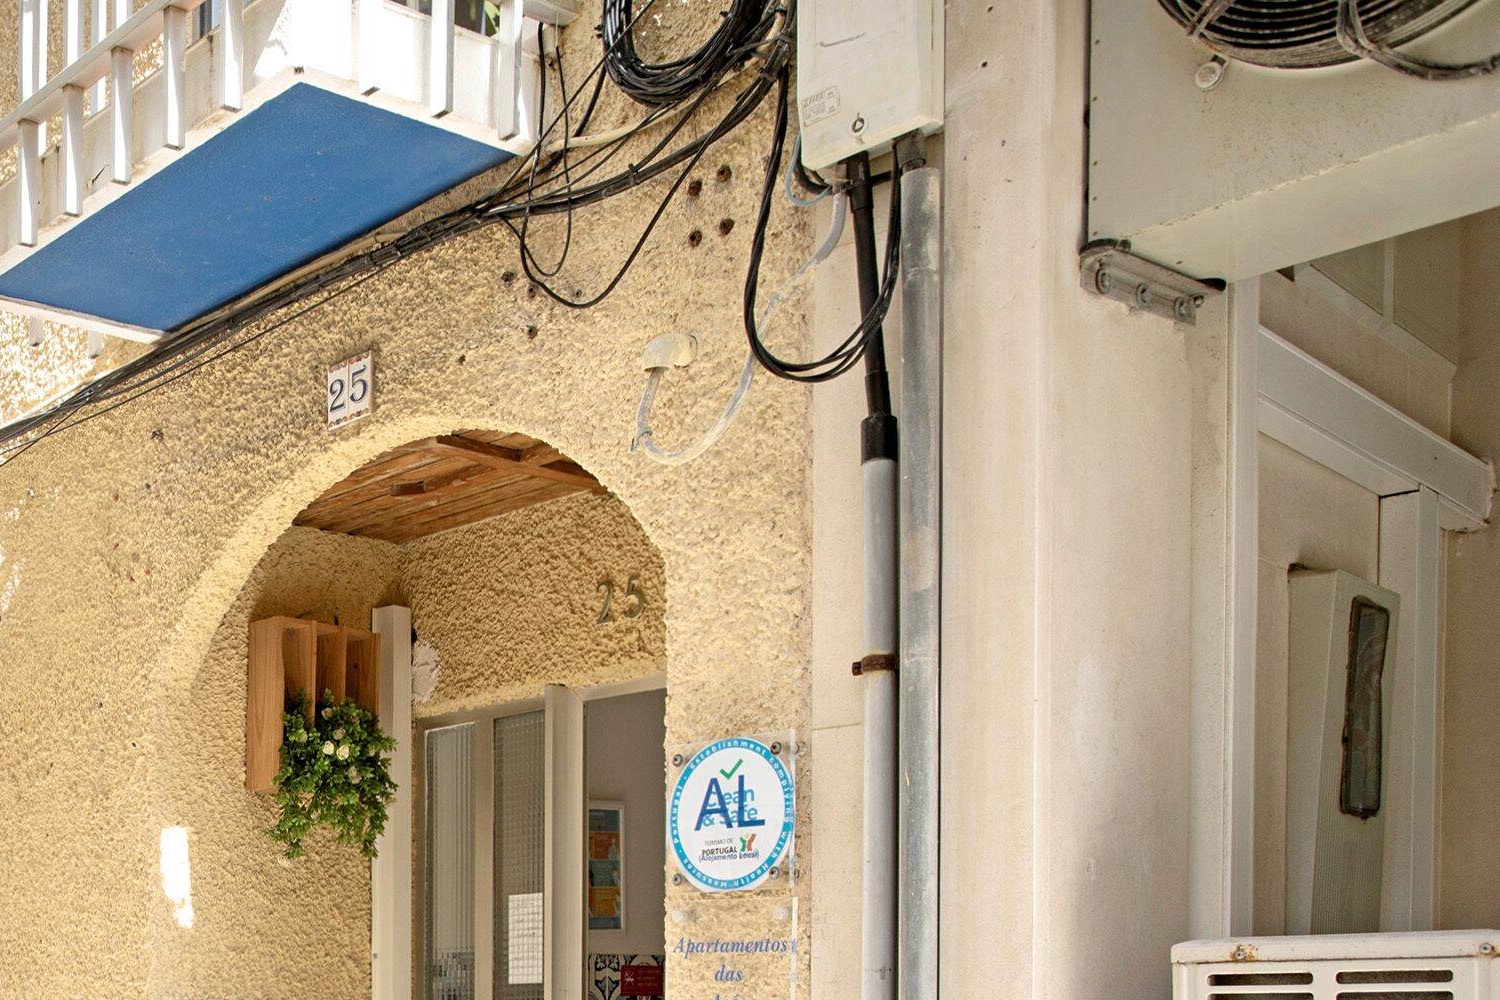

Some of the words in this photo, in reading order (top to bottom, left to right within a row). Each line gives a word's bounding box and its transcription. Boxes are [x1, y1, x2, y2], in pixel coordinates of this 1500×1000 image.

[329, 365, 368, 412] 25
[596, 574, 645, 625] 25
[690, 738, 767, 770] Establishment
[694, 774, 766, 831] AL
[707, 788, 755, 807] Cean
[769, 756, 792, 822] complying
[671, 785, 684, 844] Portugal
[702, 814, 715, 827] &
[701, 846, 738, 856] PORTUGAL
[771, 831, 789, 860] with
[683, 858, 729, 889] Measures
[732, 863, 771, 888] Health
[673, 937, 788, 960] Apartamentos
[714, 964, 744, 982] das
